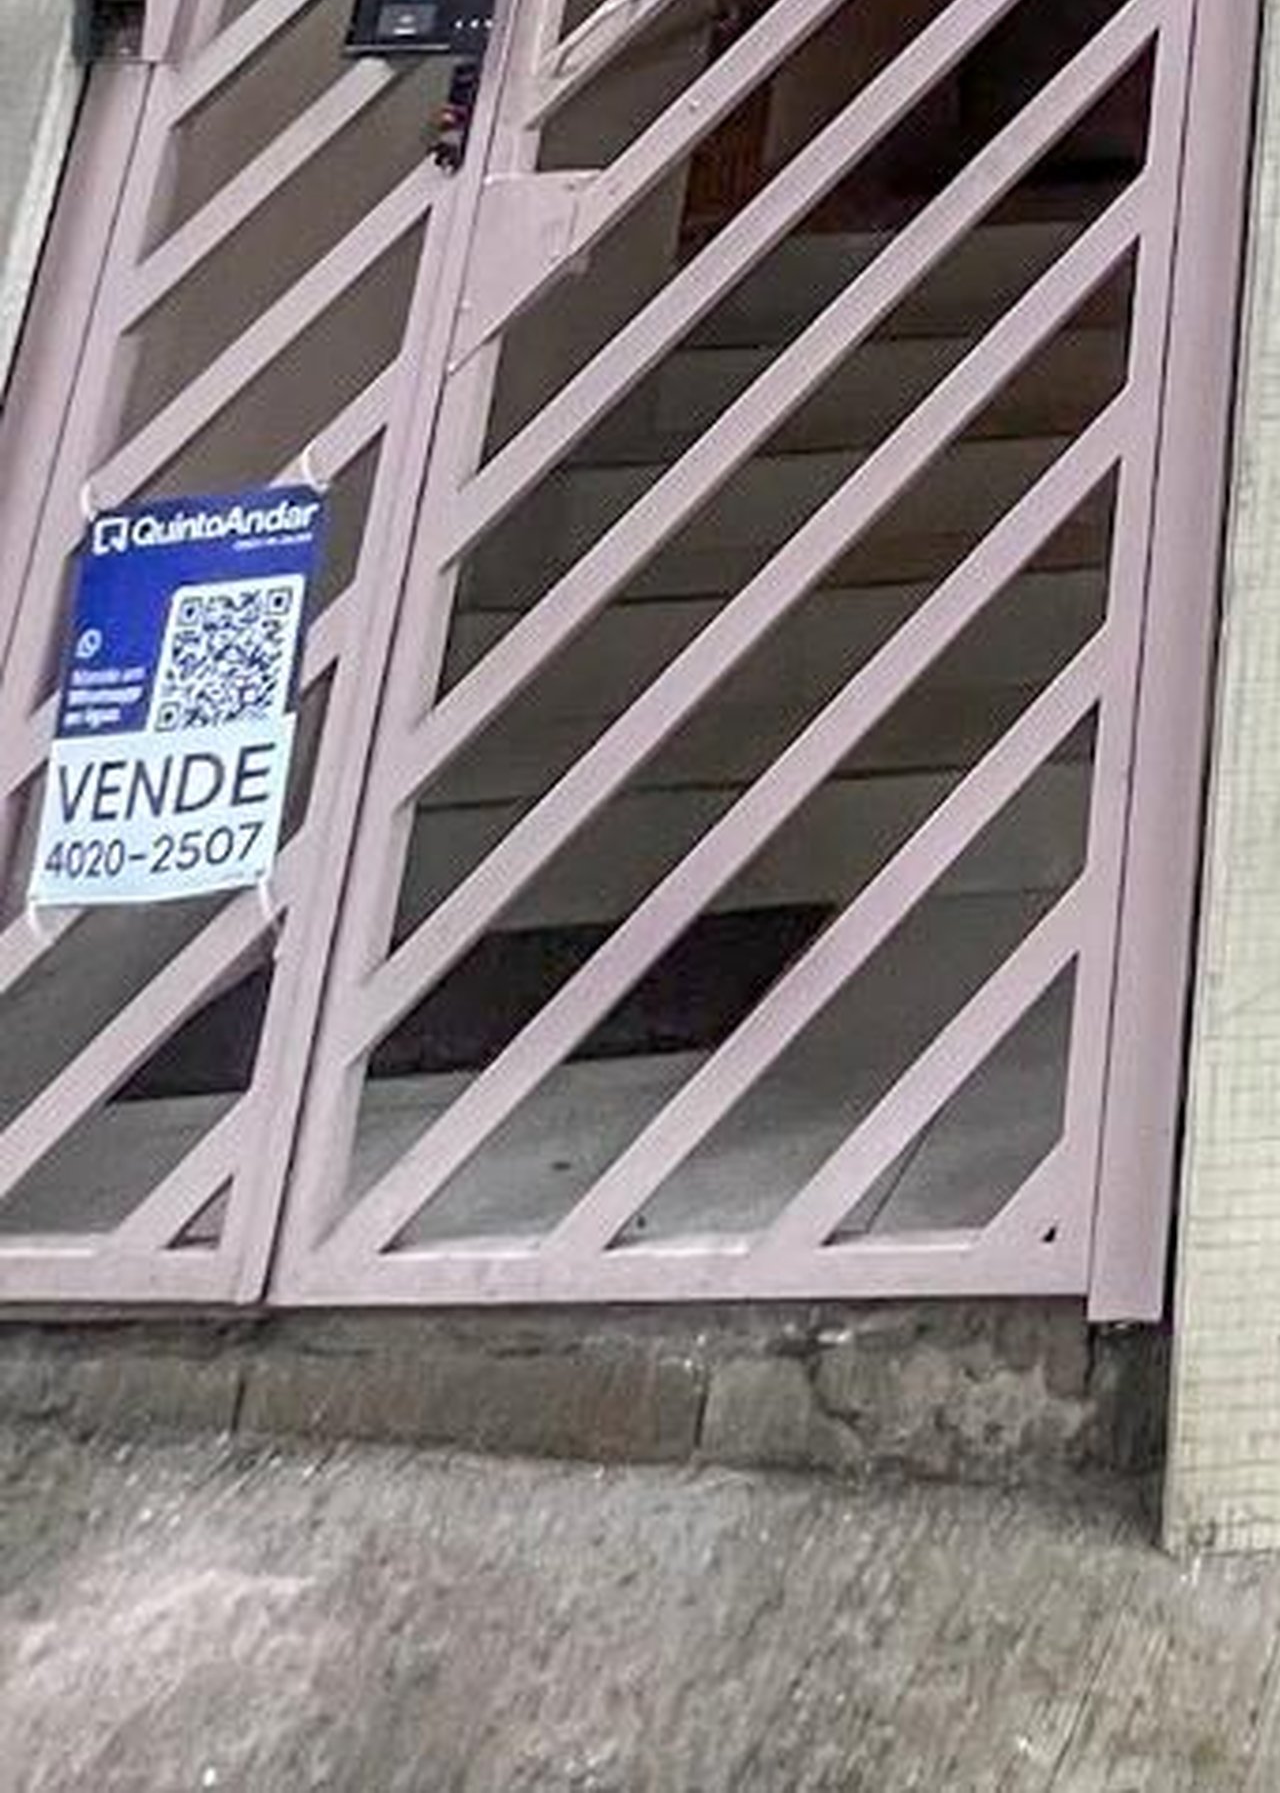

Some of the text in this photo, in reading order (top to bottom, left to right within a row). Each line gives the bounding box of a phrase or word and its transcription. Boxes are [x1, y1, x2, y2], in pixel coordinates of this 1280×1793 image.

[132, 501, 320, 546] QuintoAndar
[58, 742, 276, 824] VENDE
[45, 821, 264, 878] 4020-2507
